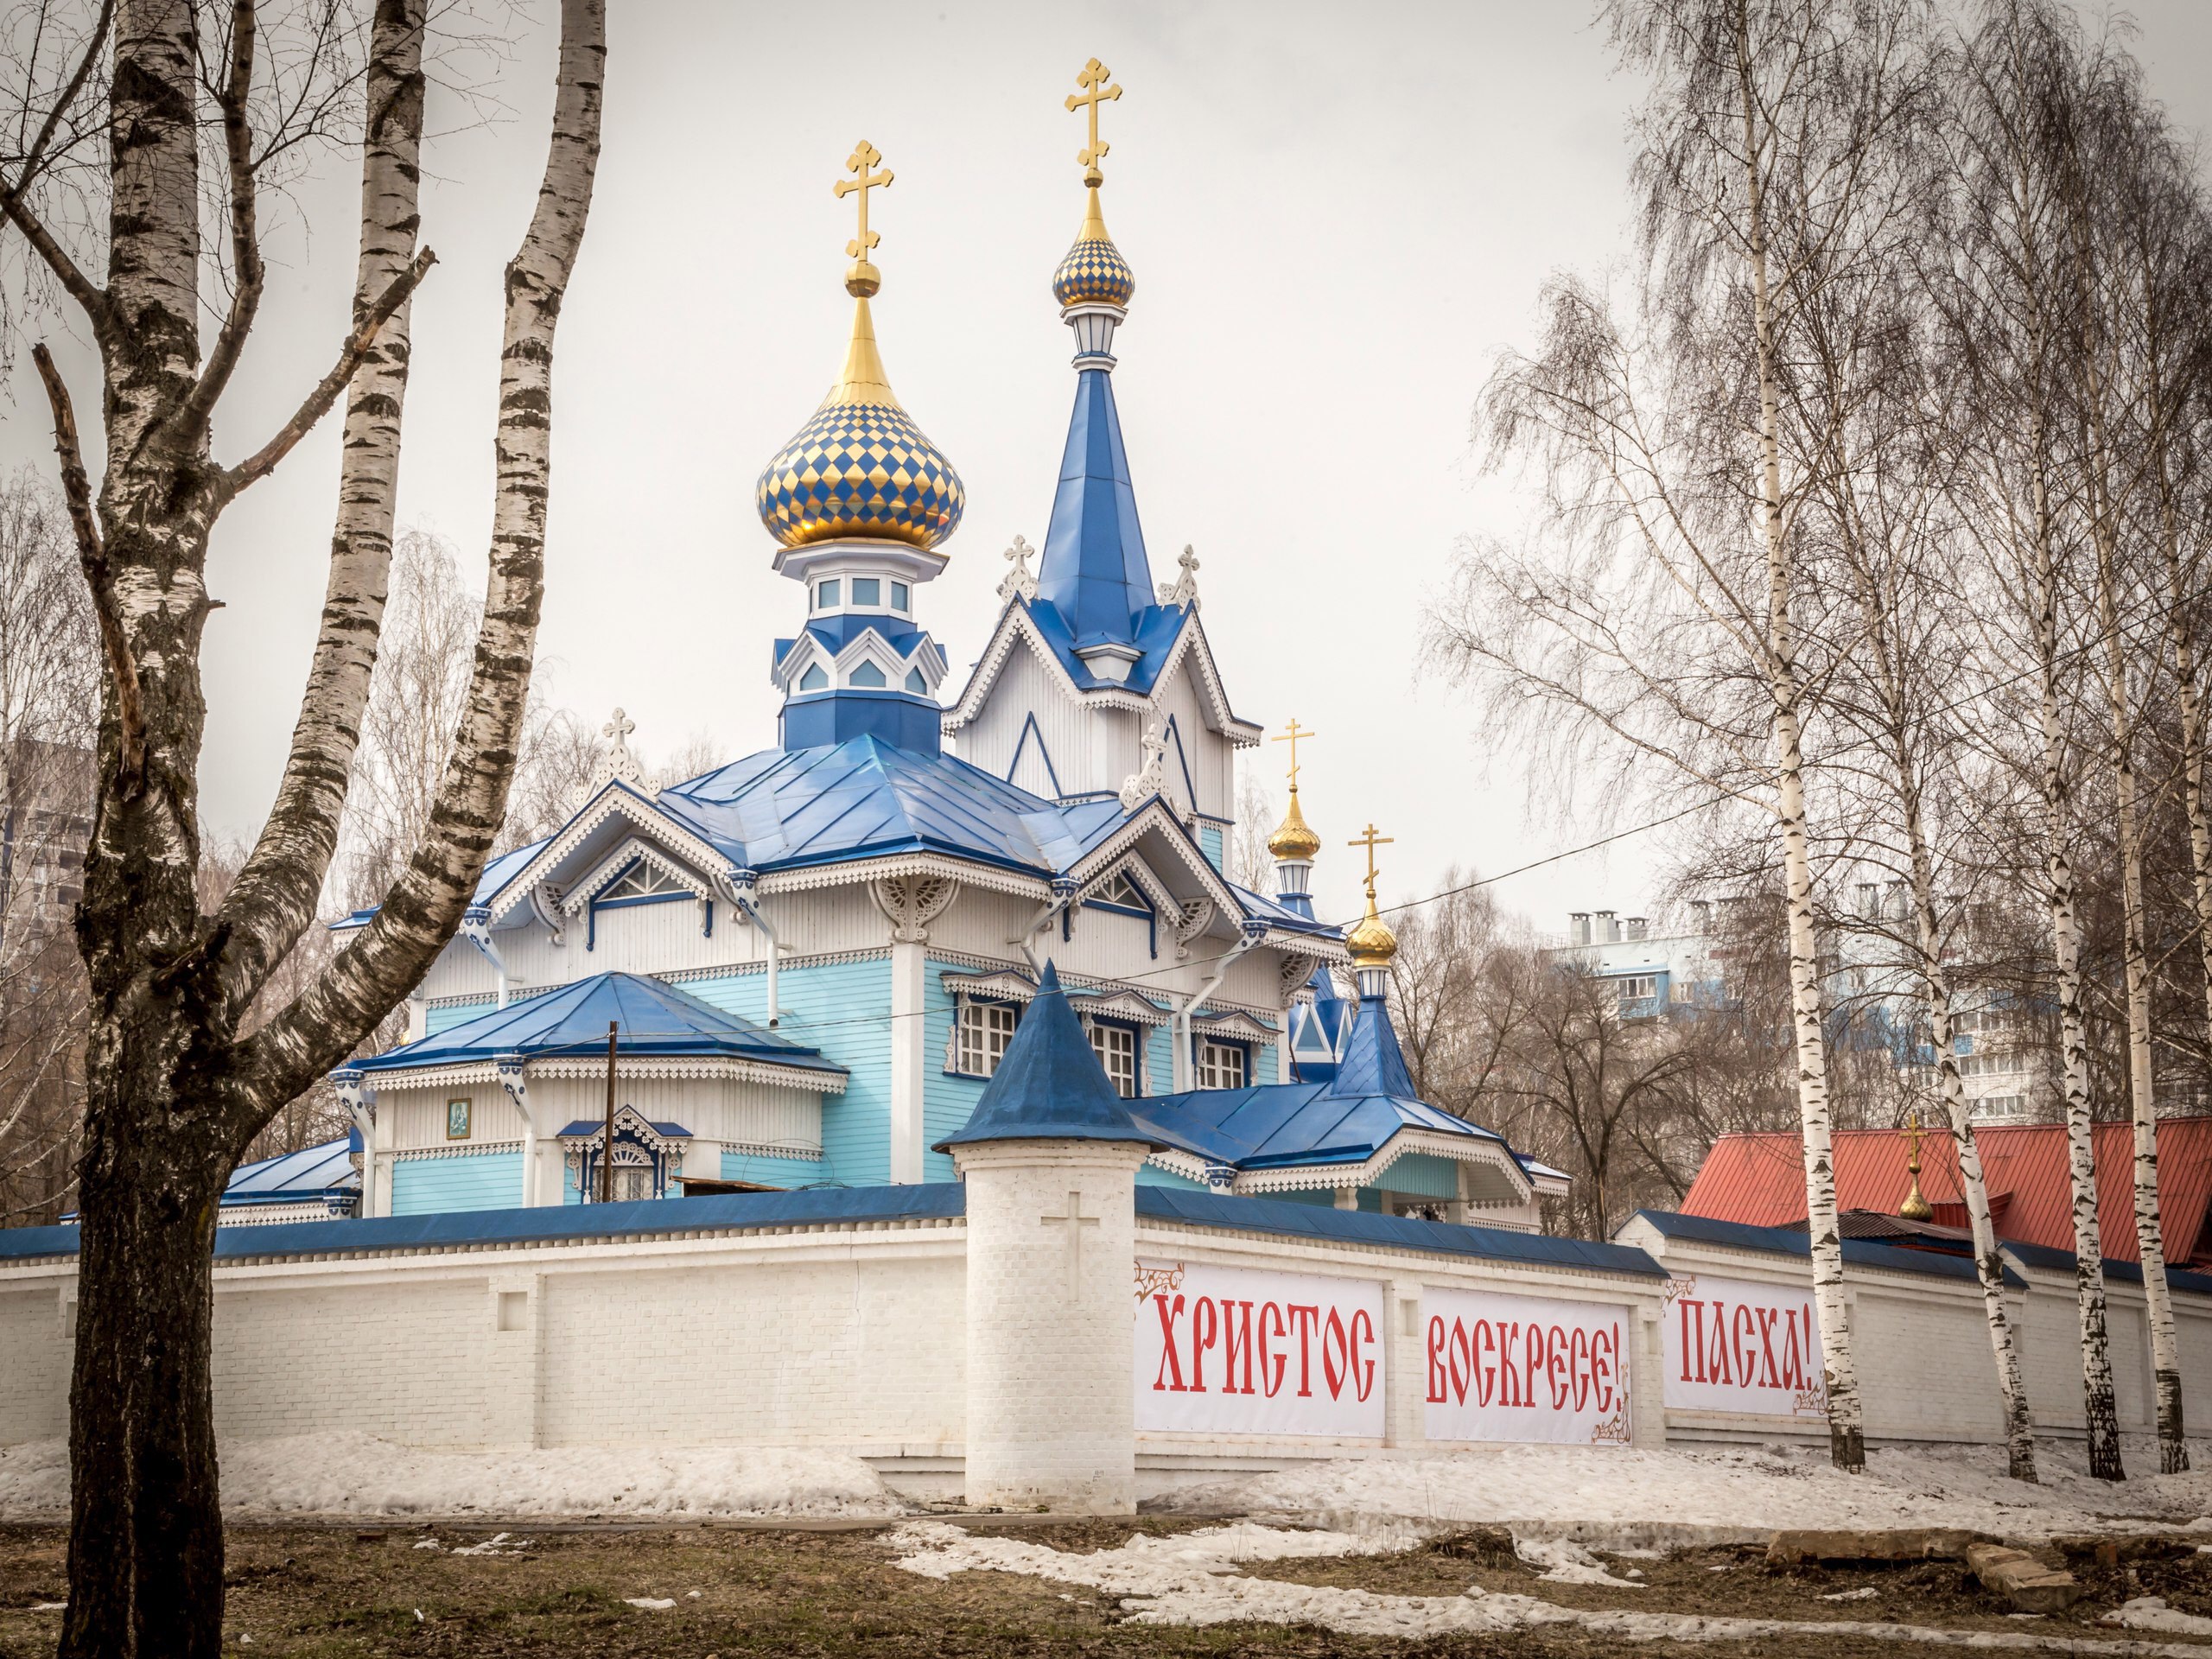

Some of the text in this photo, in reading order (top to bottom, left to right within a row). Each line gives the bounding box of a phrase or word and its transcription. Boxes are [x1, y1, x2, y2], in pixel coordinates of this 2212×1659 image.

[1154, 1294, 1376, 1402] ХРИСТОС
[1427, 1315, 1621, 1413] ВОСКРЕСЕ!
[1678, 1299, 1812, 1391] ПАСХА!
